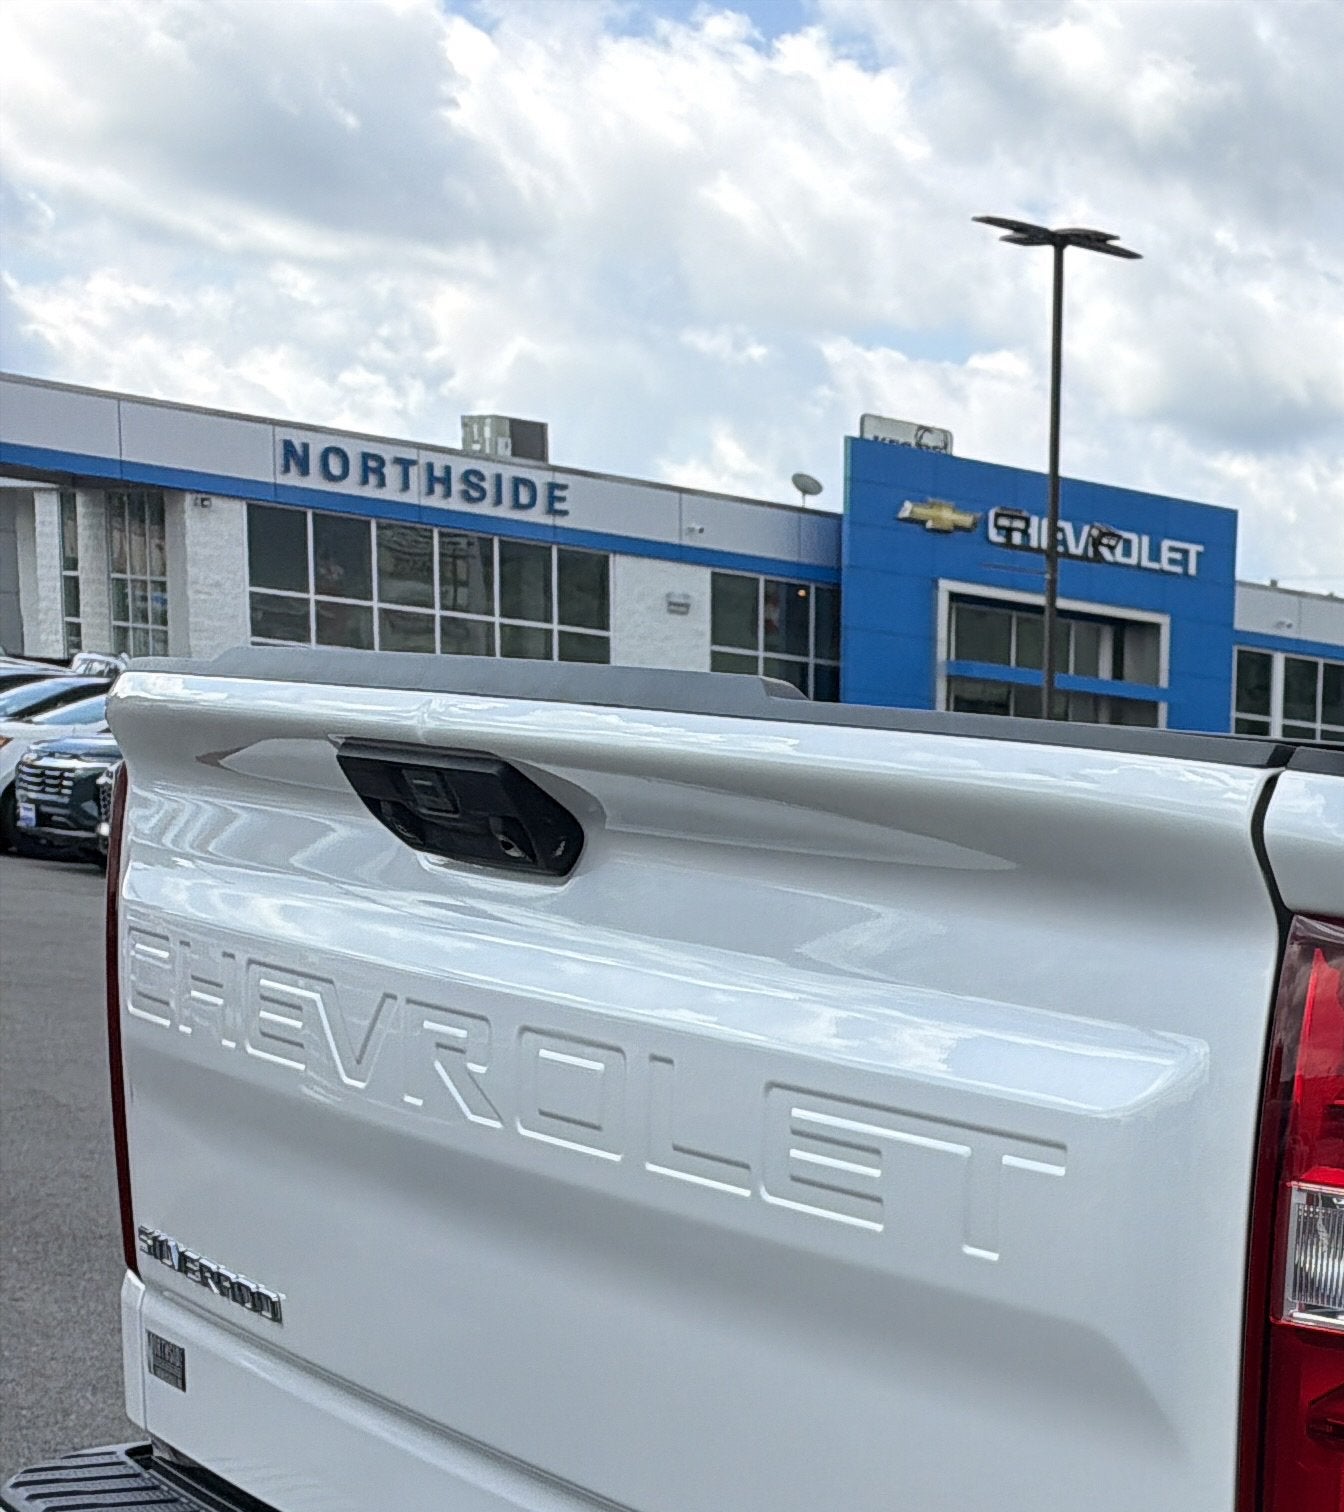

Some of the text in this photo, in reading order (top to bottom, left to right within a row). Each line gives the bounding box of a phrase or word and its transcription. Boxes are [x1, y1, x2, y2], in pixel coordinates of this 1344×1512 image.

[281, 438, 570, 517] NORTHSIDE
[987, 505, 1205, 577] CHEVROLET
[126, 924, 1068, 1262] CHEVROLET
[137, 1224, 287, 1324] SILVERADO
